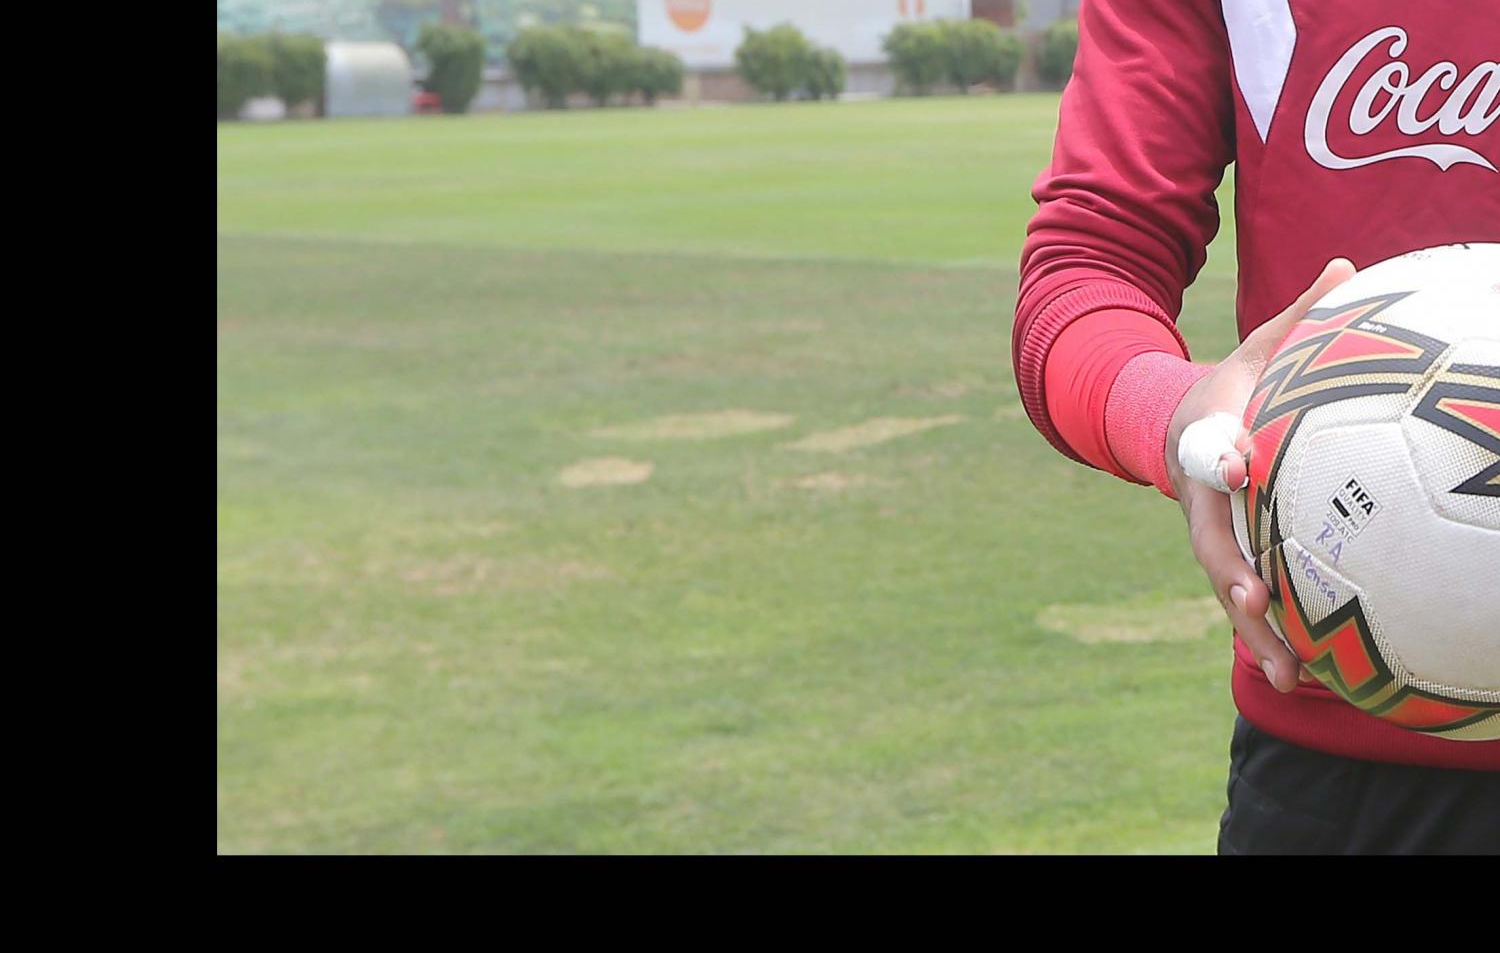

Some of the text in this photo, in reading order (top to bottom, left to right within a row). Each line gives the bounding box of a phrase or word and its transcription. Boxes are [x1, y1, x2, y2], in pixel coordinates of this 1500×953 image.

[1339, 489, 1367, 521] QUALITY
[1345, 478, 1374, 515] FIFA
[1348, 517, 1360, 531] PRO
